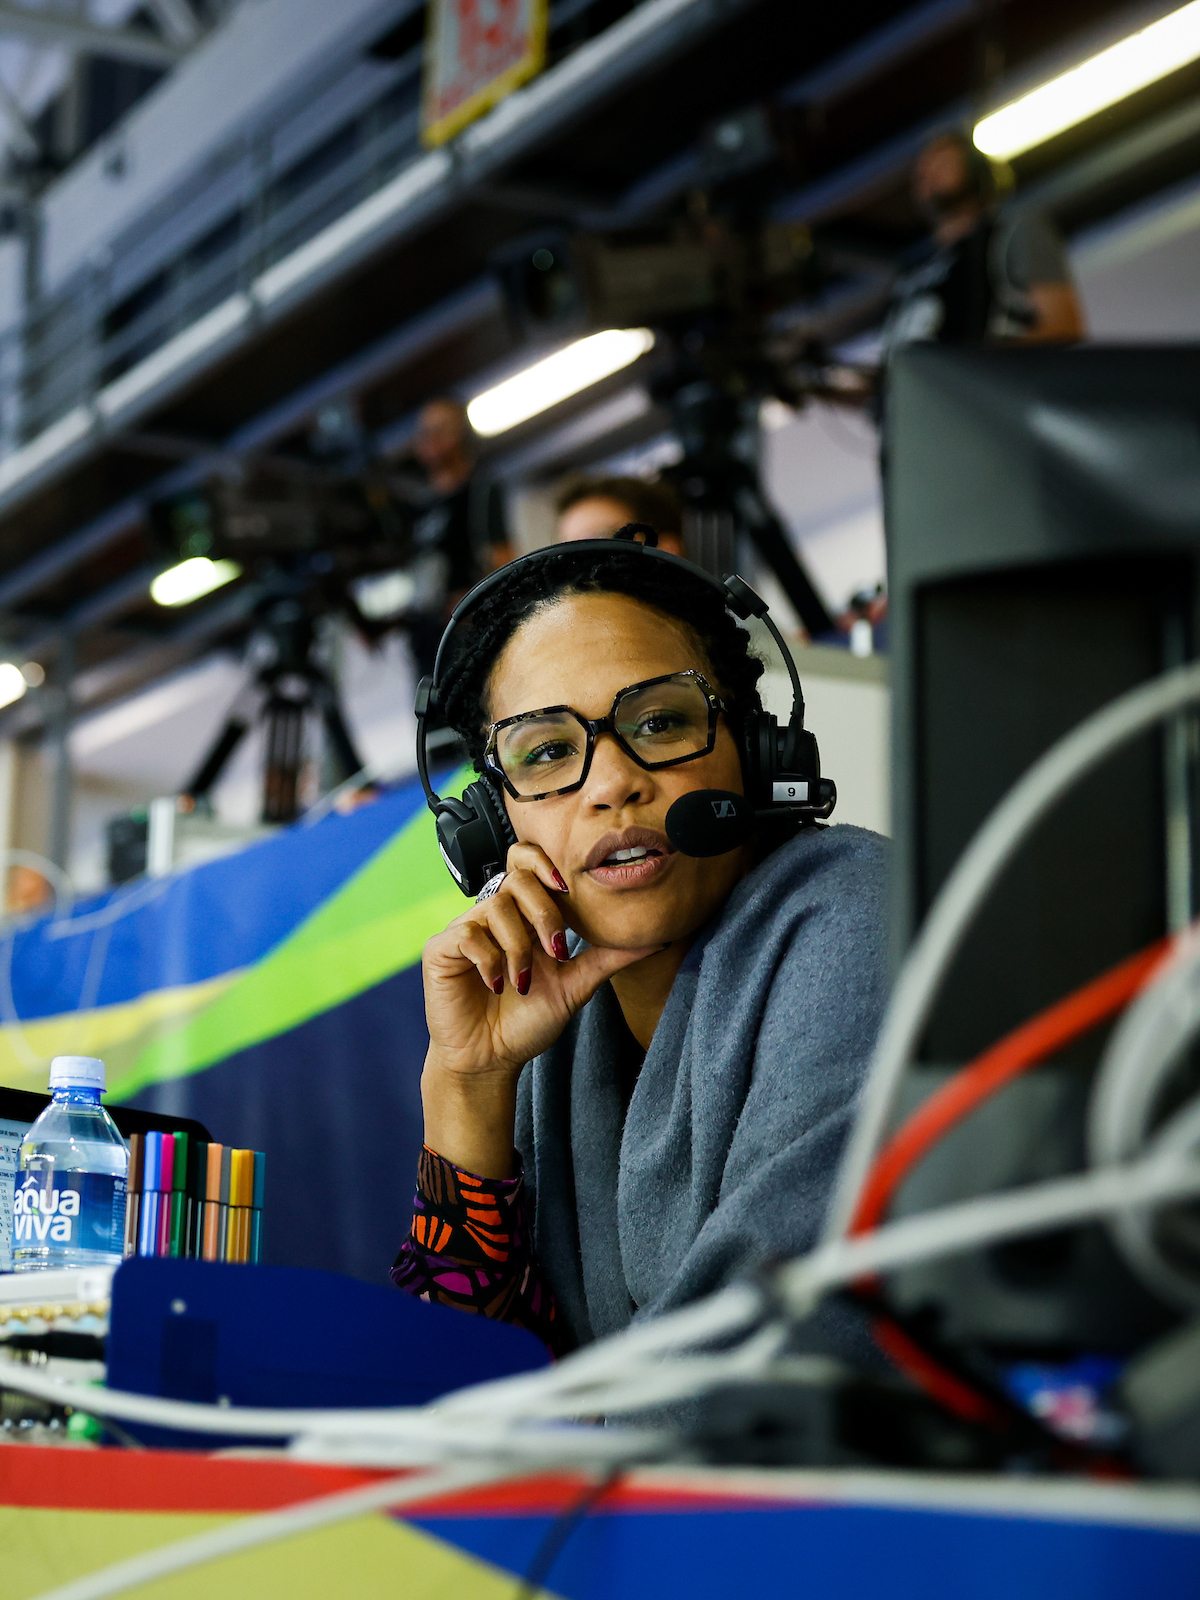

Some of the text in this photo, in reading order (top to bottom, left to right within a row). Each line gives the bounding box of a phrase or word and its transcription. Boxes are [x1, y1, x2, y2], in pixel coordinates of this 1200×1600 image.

[787, 787, 796, 797] 9
[14, 1189, 81, 1216] aqua
[13, 1215, 72, 1242] viva
